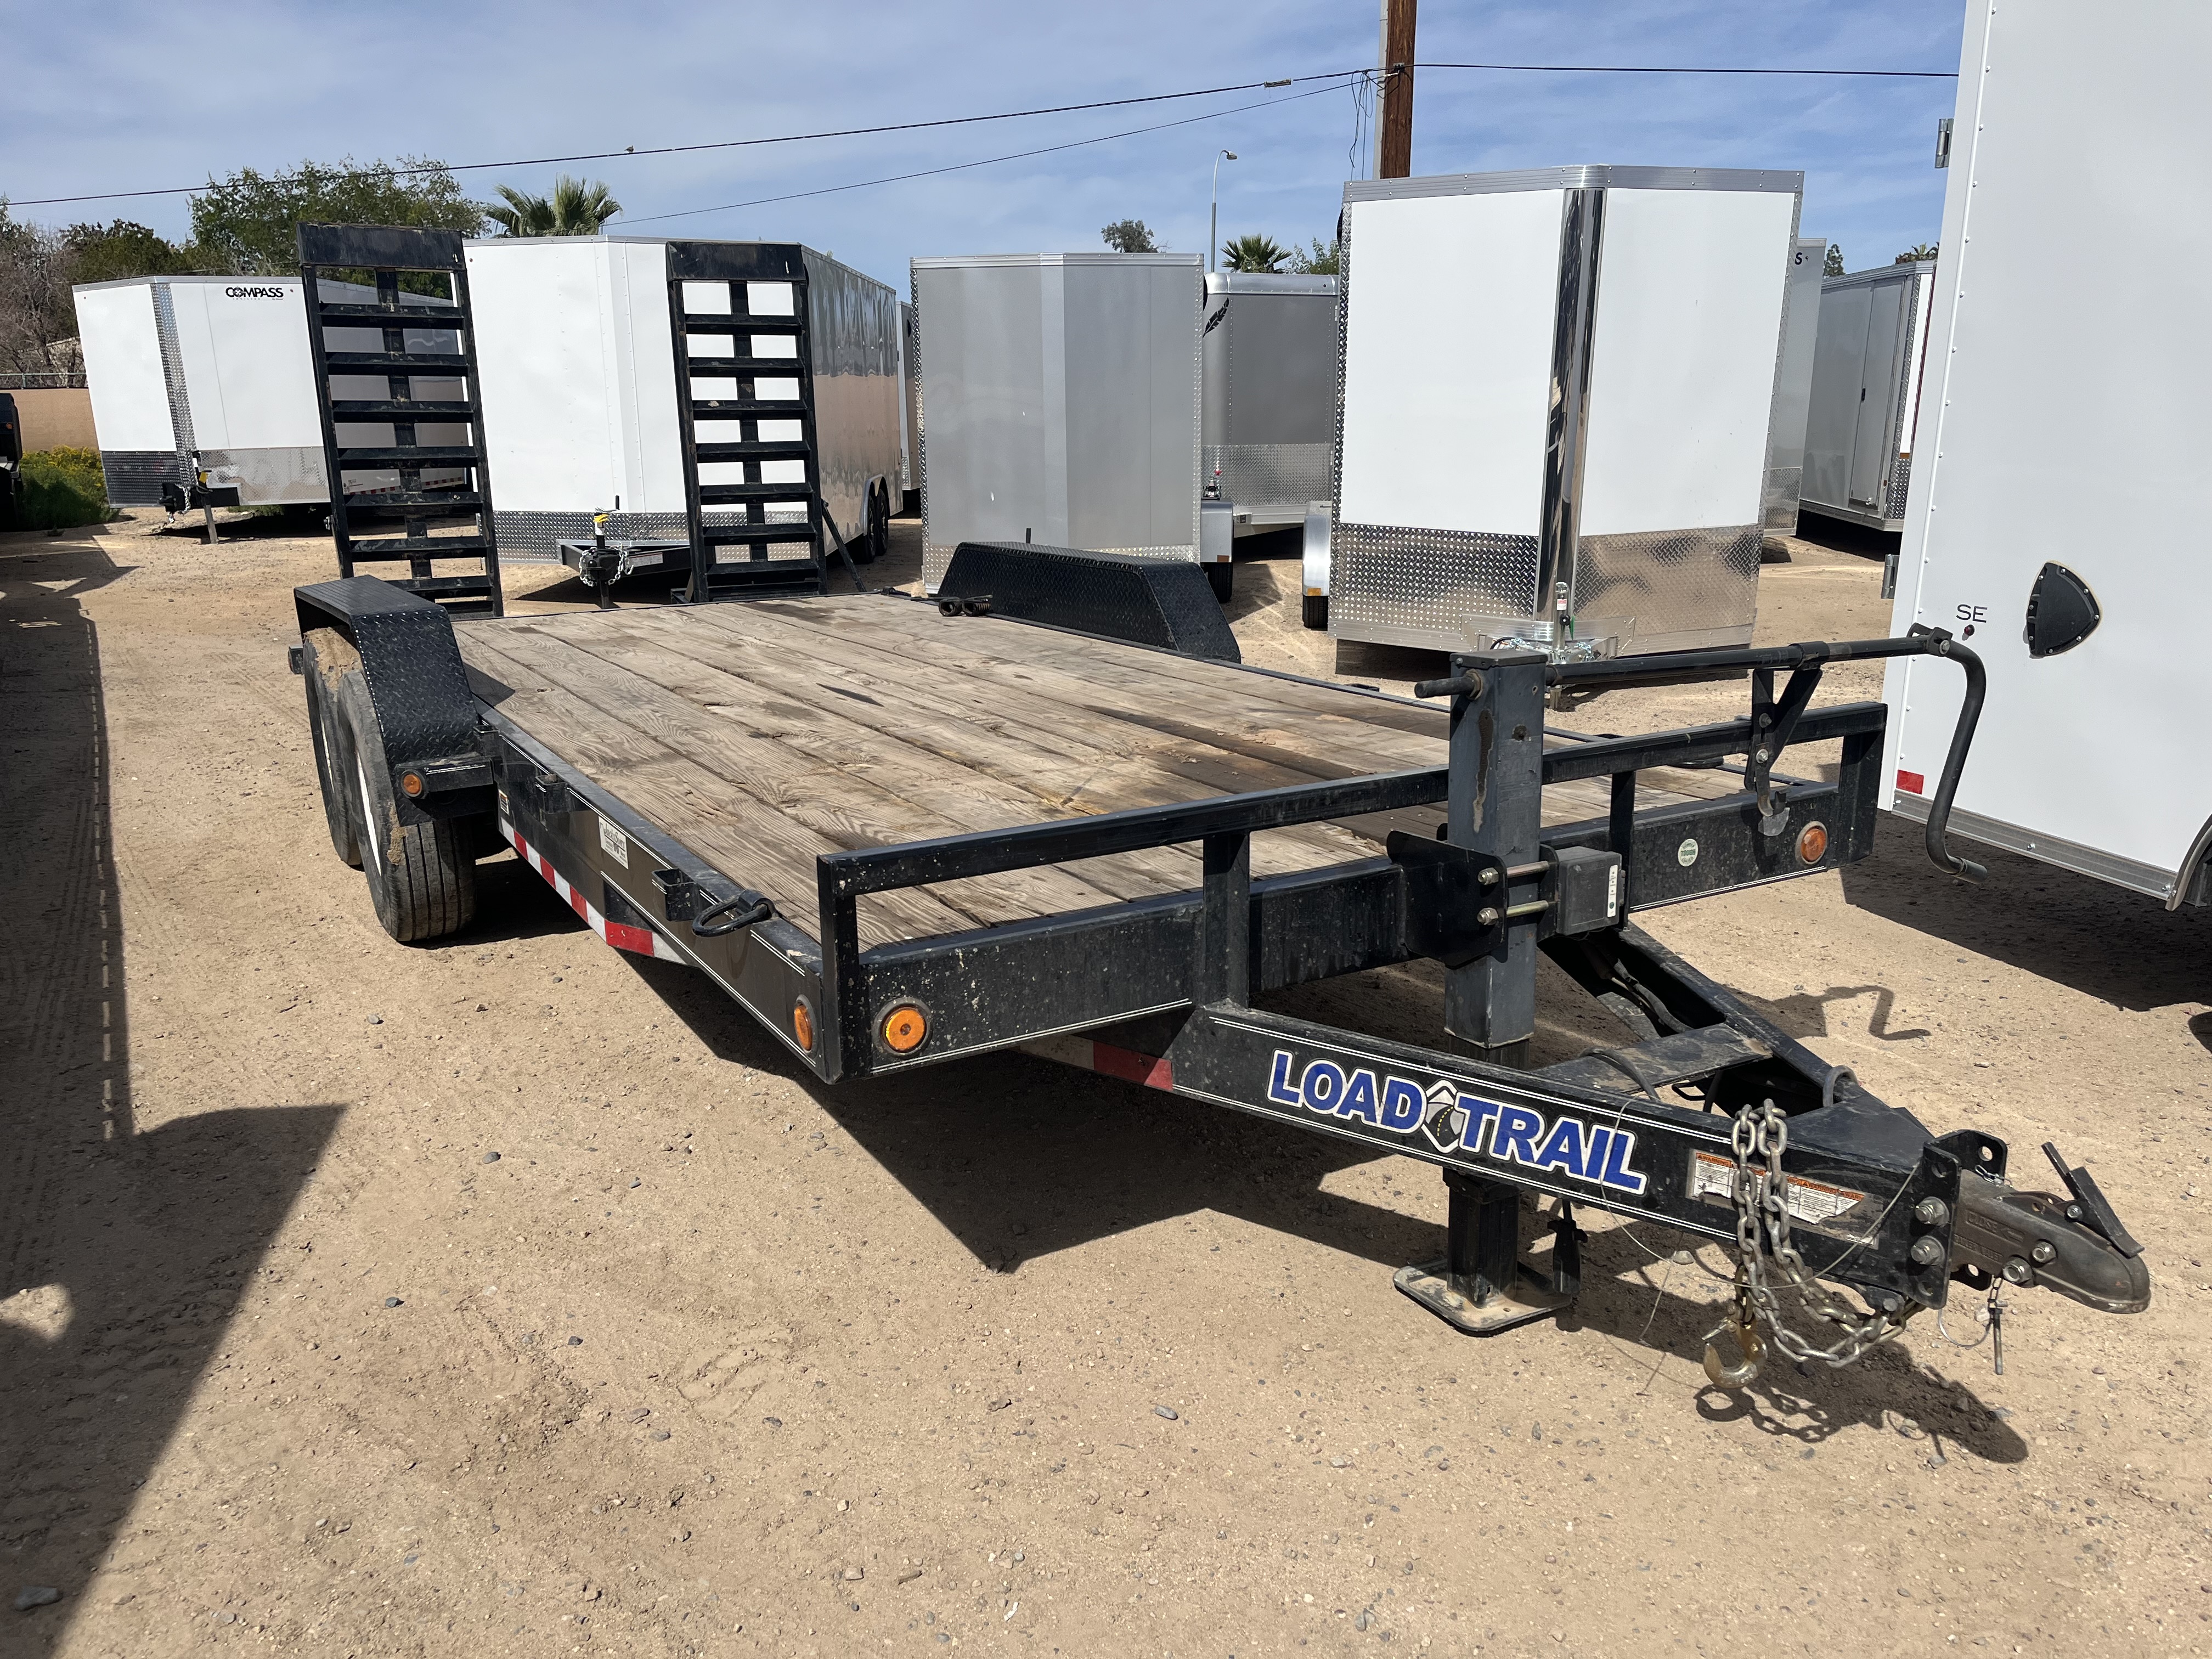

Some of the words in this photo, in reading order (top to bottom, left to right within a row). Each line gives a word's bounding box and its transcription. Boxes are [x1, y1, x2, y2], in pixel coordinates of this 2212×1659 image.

[1795, 252, 1802, 265] S
[225, 286, 284, 297] COMPASS
[1956, 604, 1988, 623] SE
[1268, 1050, 1426, 1133] LOAD
[1454, 1092, 1647, 1195] TRAIL
[1702, 1155, 1729, 1166] WARNING
